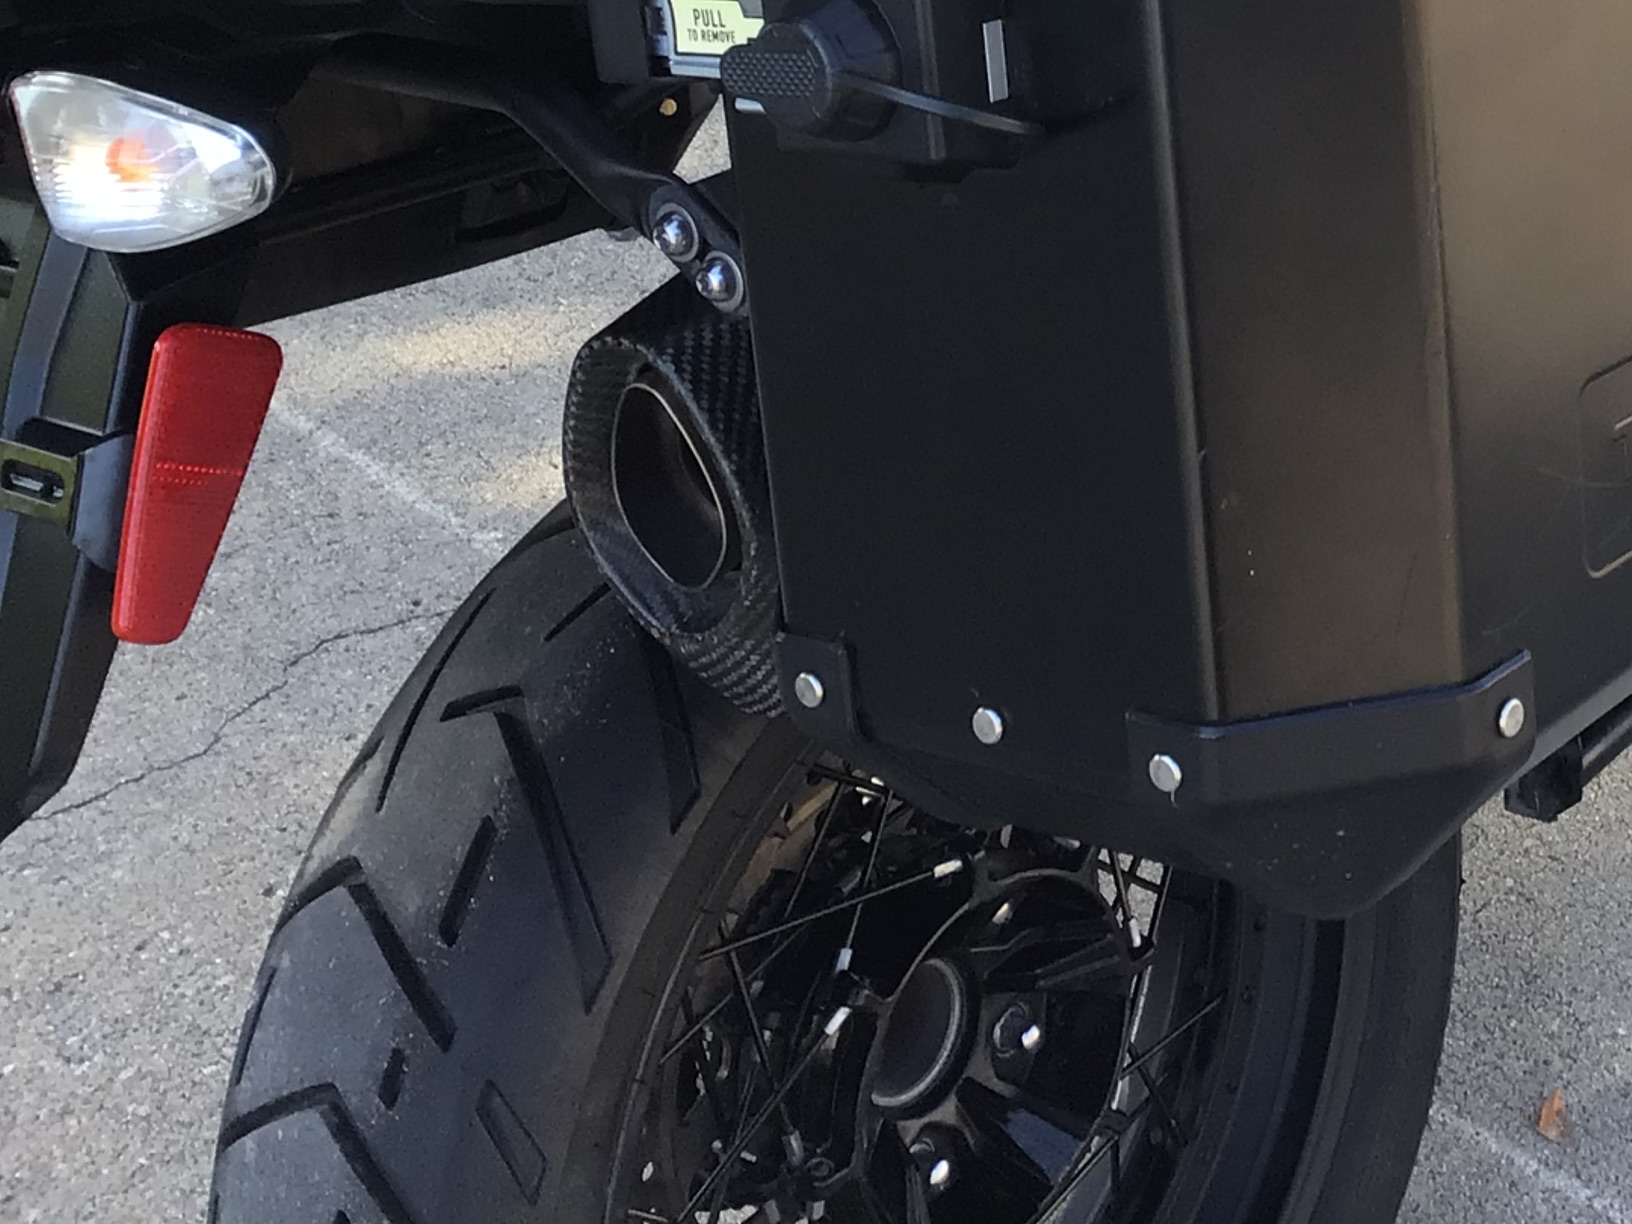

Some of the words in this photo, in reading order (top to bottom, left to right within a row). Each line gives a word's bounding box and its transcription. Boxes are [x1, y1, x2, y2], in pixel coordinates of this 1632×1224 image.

[692, 8, 728, 28] PULL
[687, 28, 699, 42] TO
[701, 29, 737, 44] REMOVE
